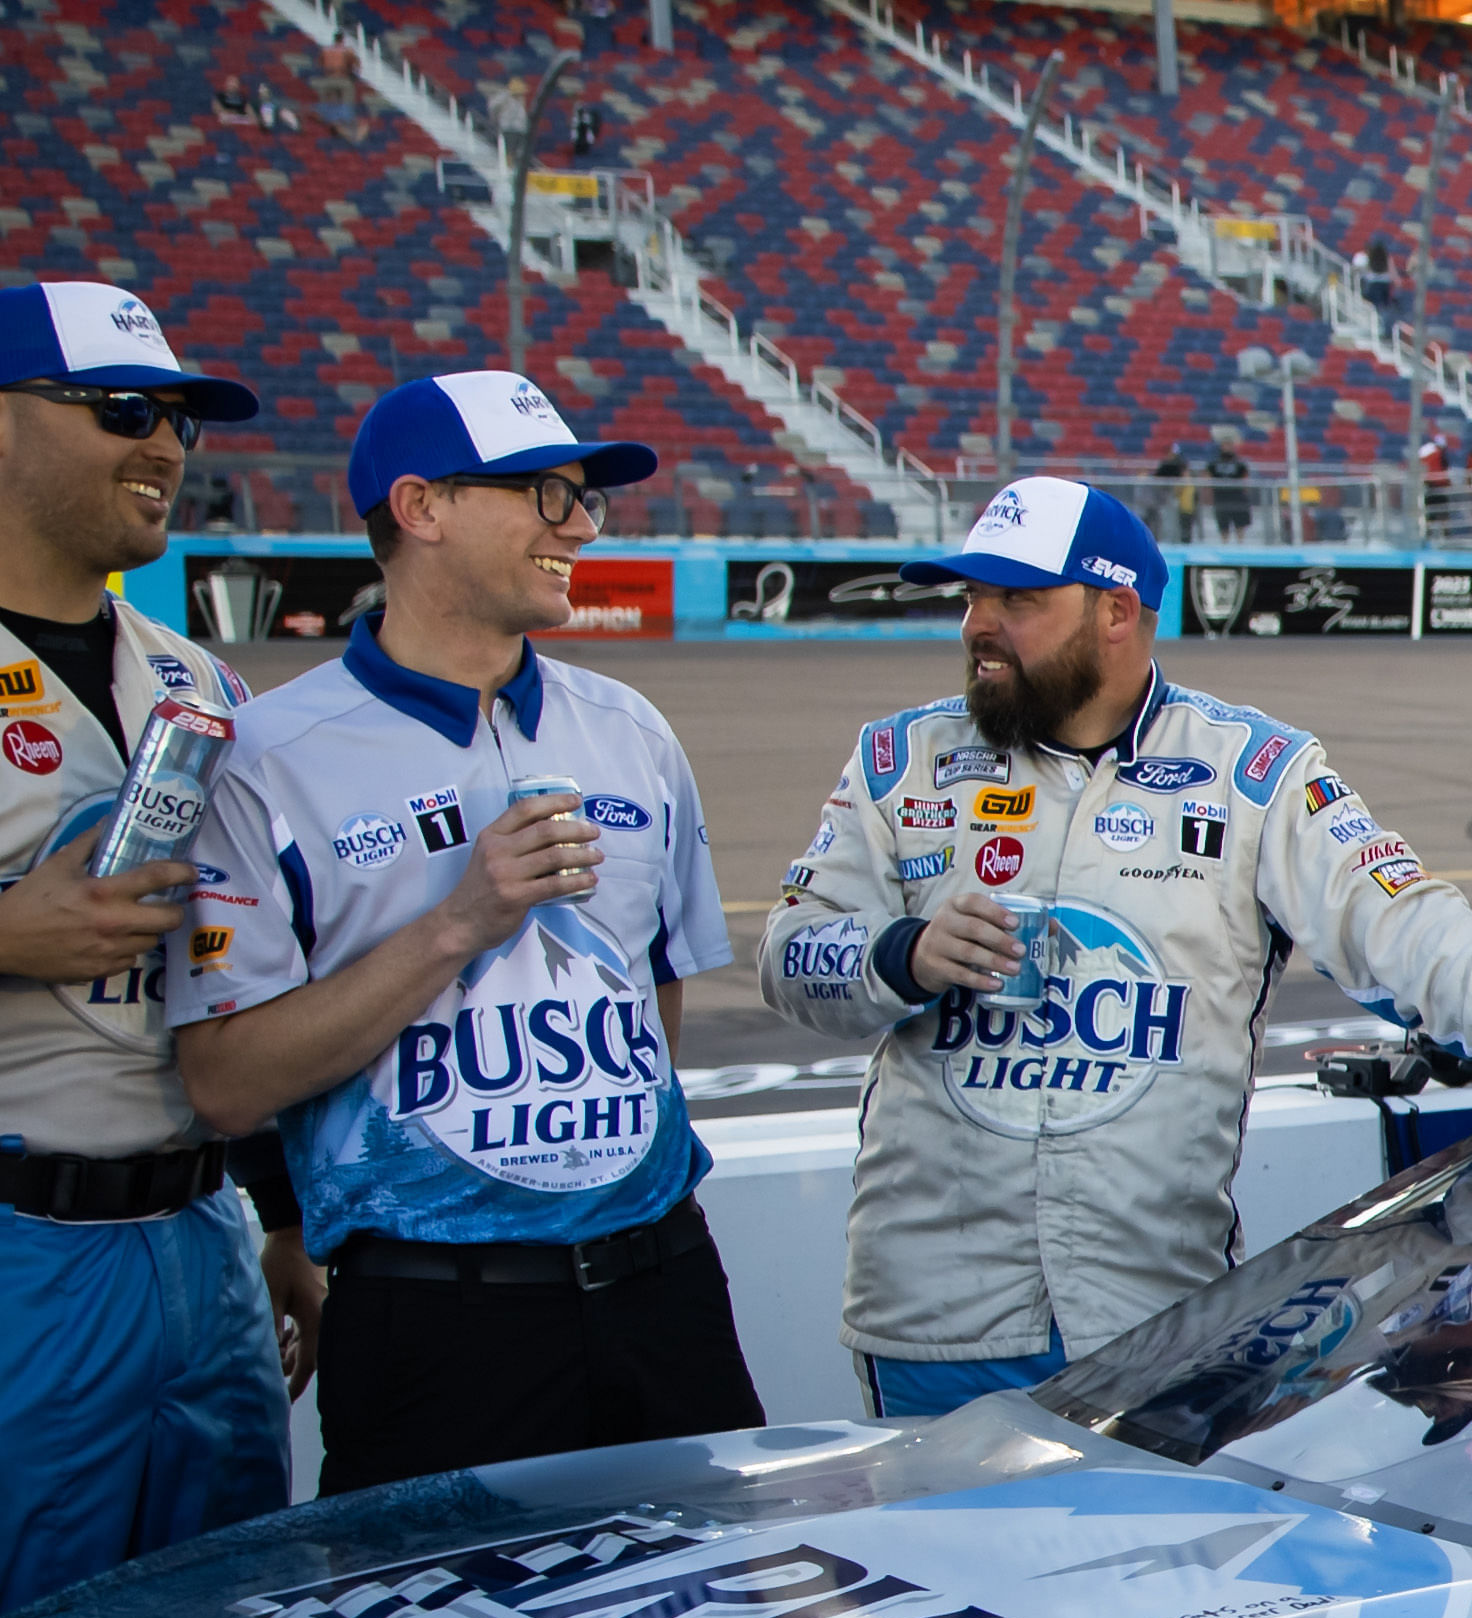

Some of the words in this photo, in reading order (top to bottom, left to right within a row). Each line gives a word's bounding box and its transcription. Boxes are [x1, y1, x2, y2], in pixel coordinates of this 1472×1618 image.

[1081, 555, 1138, 588] 4EVER
[172, 711, 211, 733] 25
[6, 724, 60, 768] Rheem
[955, 750, 998, 762] NASCAR
[1250, 739, 1286, 778] SIMPSON
[1136, 759, 1193, 787] Ford
[129, 783, 207, 824] BUSCH
[409, 788, 458, 813] Mobil
[592, 799, 640, 827] Ford
[913, 800, 946, 811] HUNT
[981, 791, 1031, 816] GW
[1182, 800, 1227, 820] Mobil
[135, 809, 187, 834] LIGHT
[429, 811, 456, 848] 1
[912, 817, 947, 827] PIZZA
[1093, 815, 1156, 838] BUSCH
[332, 818, 408, 861] BUSCH
[1111, 833, 1140, 843] LIGHT
[1193, 820, 1209, 855] 1
[354, 844, 397, 867] LIGHT
[980, 838, 1020, 879] Rheem
[783, 939, 866, 980] BUSCH
[804, 982, 851, 1001] LIGHT
[396, 995, 660, 1117] BUSCH
[961, 1055, 1127, 1094] LIGHT
[470, 1092, 648, 1154] LIGHT
[500, 1152, 559, 1168] BREWED
[589, 1149, 603, 1160] IN
[1245, 1599, 1277, 1610] on
[1279, 1595, 1302, 1604] a
